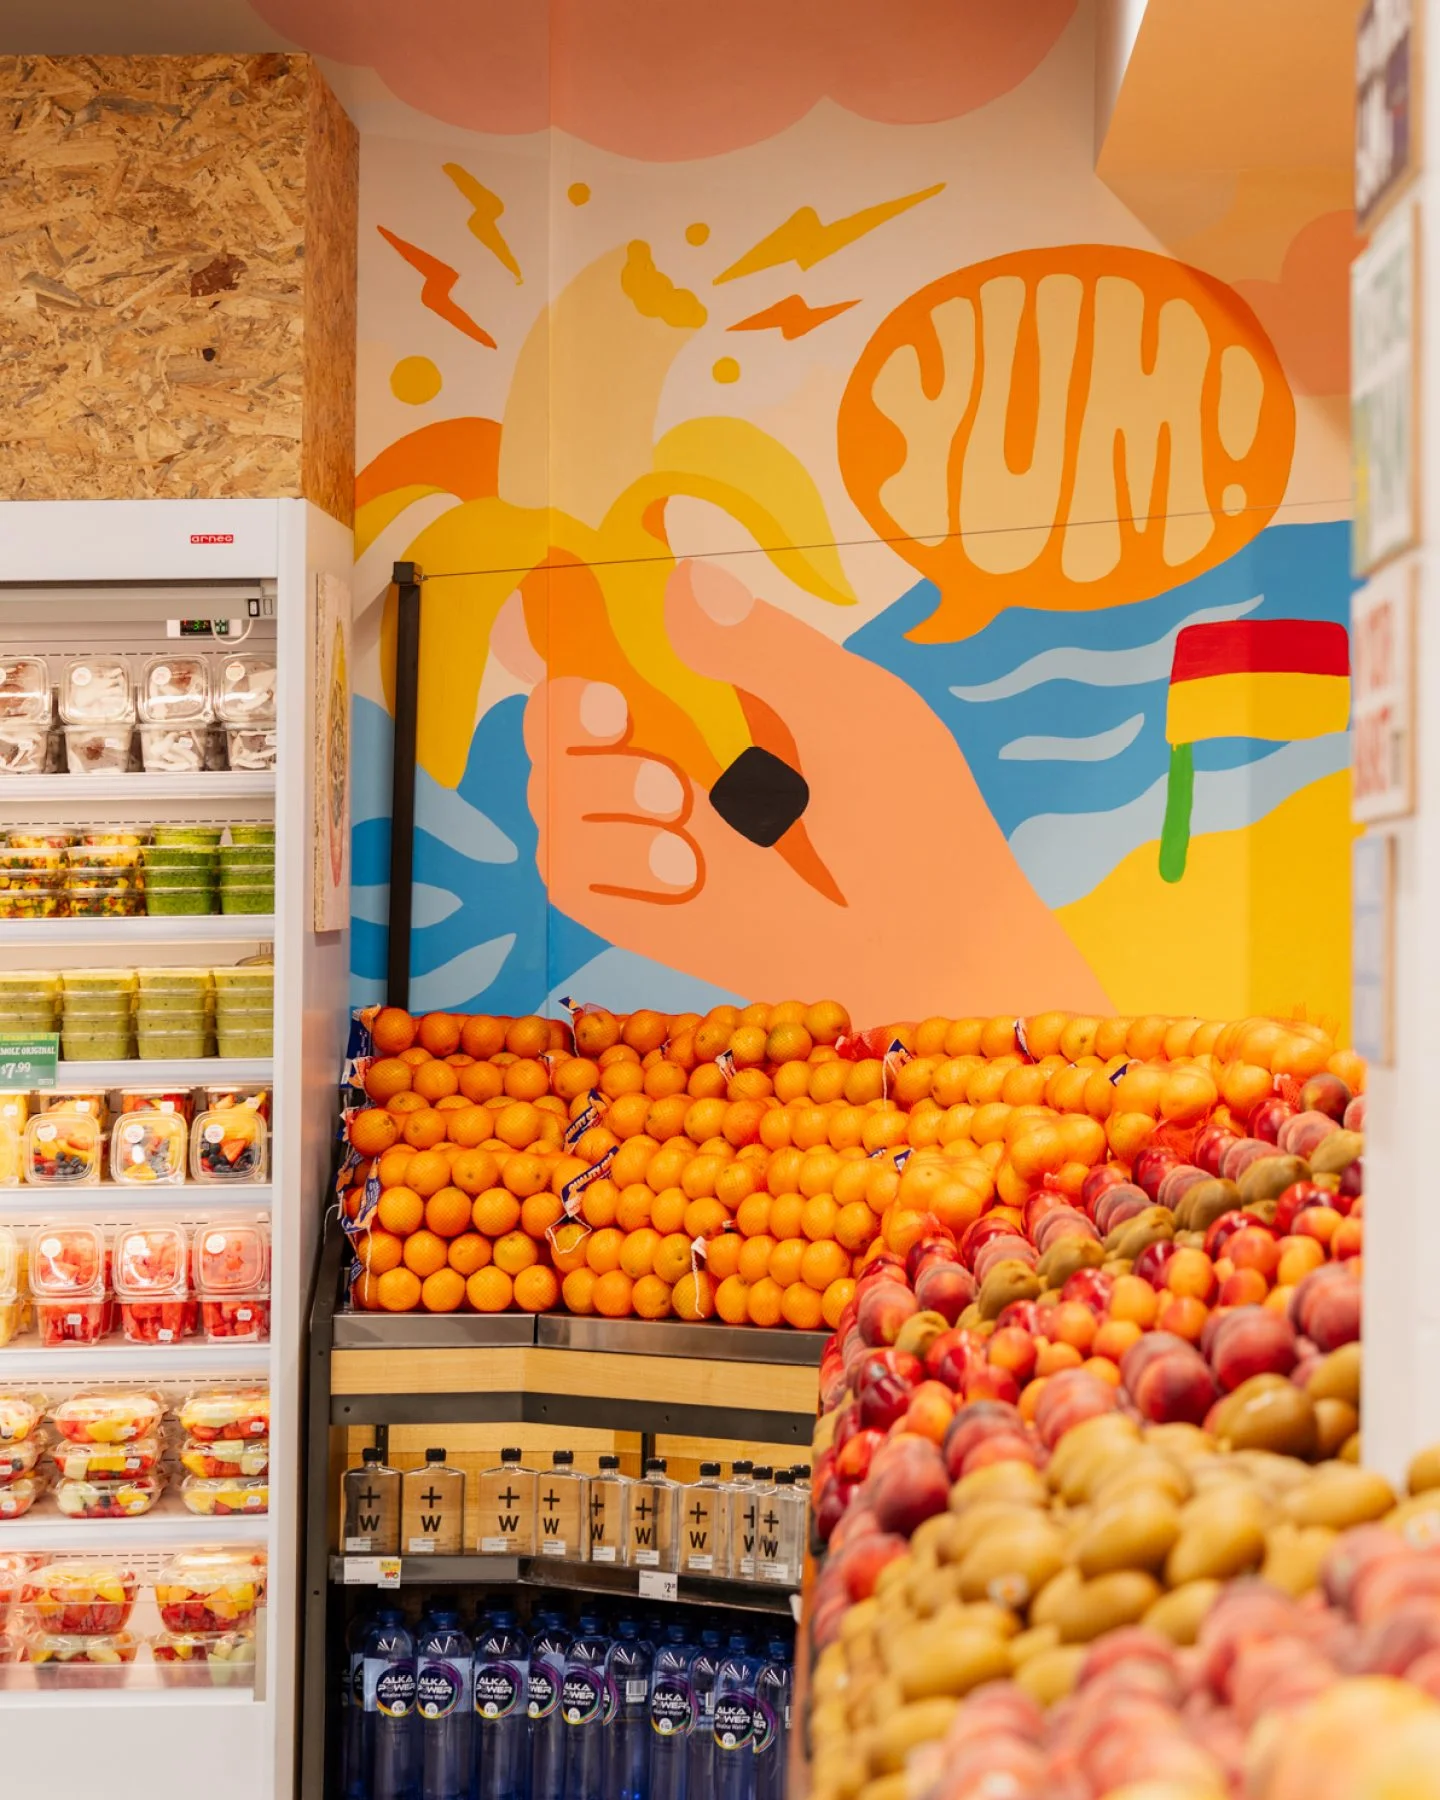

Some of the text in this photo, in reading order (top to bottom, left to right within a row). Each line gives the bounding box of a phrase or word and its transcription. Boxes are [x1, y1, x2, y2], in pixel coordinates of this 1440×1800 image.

[872, 273, 1264, 583] YUM!
[1, 1062, 30, 1078] $7.99
[360, 1515, 380, 1531] W
[421, 1515, 442, 1532] W
[499, 1515, 519, 1532] W
[543, 1517, 560, 1535] W
[590, 1524, 604, 1541] W
[635, 1527, 651, 1544] W
[690, 1531, 707, 1549] W
[763, 1540, 779, 1558] W
[382, 1675, 413, 1684] ALKA
[420, 1678, 448, 1686] ALKA
[479, 1677, 509, 1686] ALKA
[377, 1682, 416, 1692] POWER
[476, 1684, 513, 1694] POWER
[564, 1682, 591, 1691] ALKA
[655, 1692, 683, 1701] ALKA
[652, 1700, 688, 1709] POWER
[717, 1706, 746, 1715] ALKA
[715, 1714, 750, 1724] POWER
